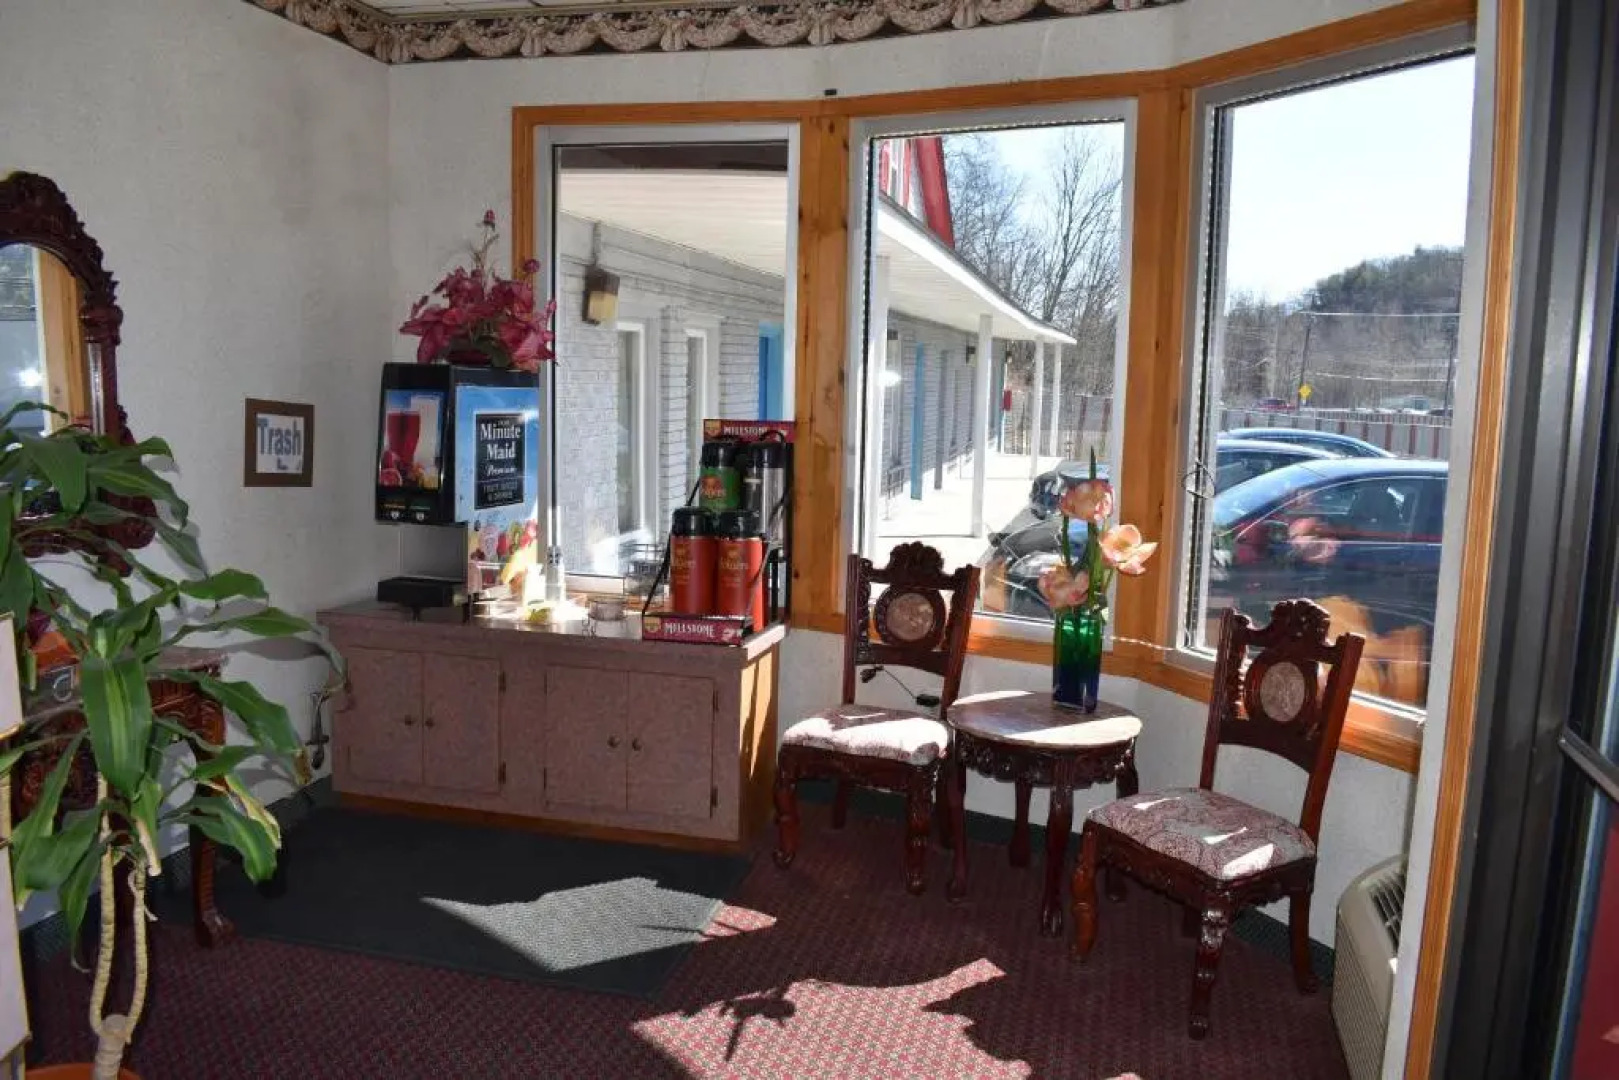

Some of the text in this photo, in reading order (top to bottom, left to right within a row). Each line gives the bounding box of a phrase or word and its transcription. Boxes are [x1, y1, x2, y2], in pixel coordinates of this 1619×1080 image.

[257, 418, 301, 456] Trash
[480, 423, 521, 440] Minute
[486, 440, 516, 460] Maid
